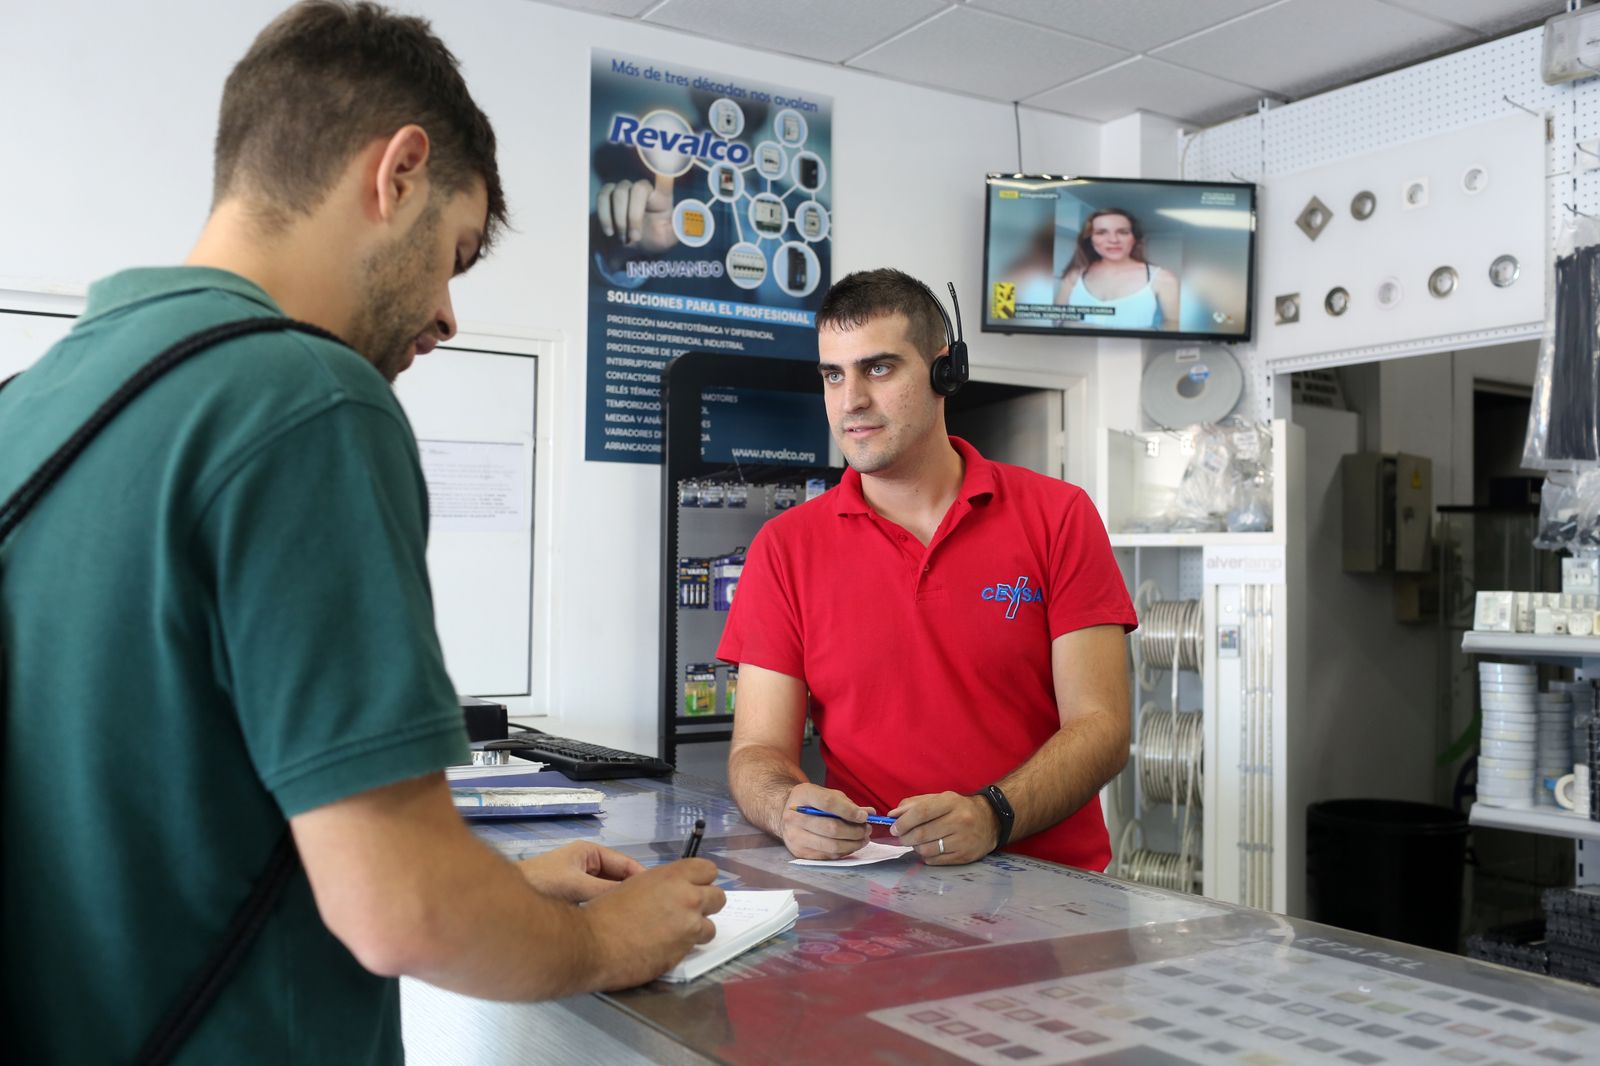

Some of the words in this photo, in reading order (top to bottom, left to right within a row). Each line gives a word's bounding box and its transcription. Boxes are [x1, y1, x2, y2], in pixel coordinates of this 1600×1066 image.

[610, 58, 640, 77] Más
[643, 66, 661, 81] de
[665, 70, 689, 87] tres
[692, 76, 746, 98] décadas
[750, 90, 771, 103] nos
[774, 95, 818, 112] avalan
[609, 116, 750, 164] Revalco
[626, 260, 724, 279] INNOVANDO
[607, 290, 684, 310] SOLUCIONES
[686, 299, 716, 314] PARA
[719, 303, 732, 316] EL
[735, 305, 810, 325] PROFESIONAL
[606, 314, 655, 328] PROTECCIÓN
[724, 326, 730, 335] Y
[730, 327, 775, 341] DIFERENCIAL
[606, 328, 655, 341] PROTECCIÓN
[656, 333, 703, 347] DIFERENCIAL
[703, 338, 744, 351] INDUSTRIAL
[606, 342, 660, 356] PROTECTORES
[660, 347, 671, 357] DE
[606, 370, 661, 383] CONTACTORES
[605, 399, 661, 412] TEMPORIZACIÓ
[604, 412, 636, 424] MEDIDA
[731, 447, 816, 463] www.revalco.org
[687, 567, 709, 577] VARTA
[980, 575, 1044, 620] CEYSA
